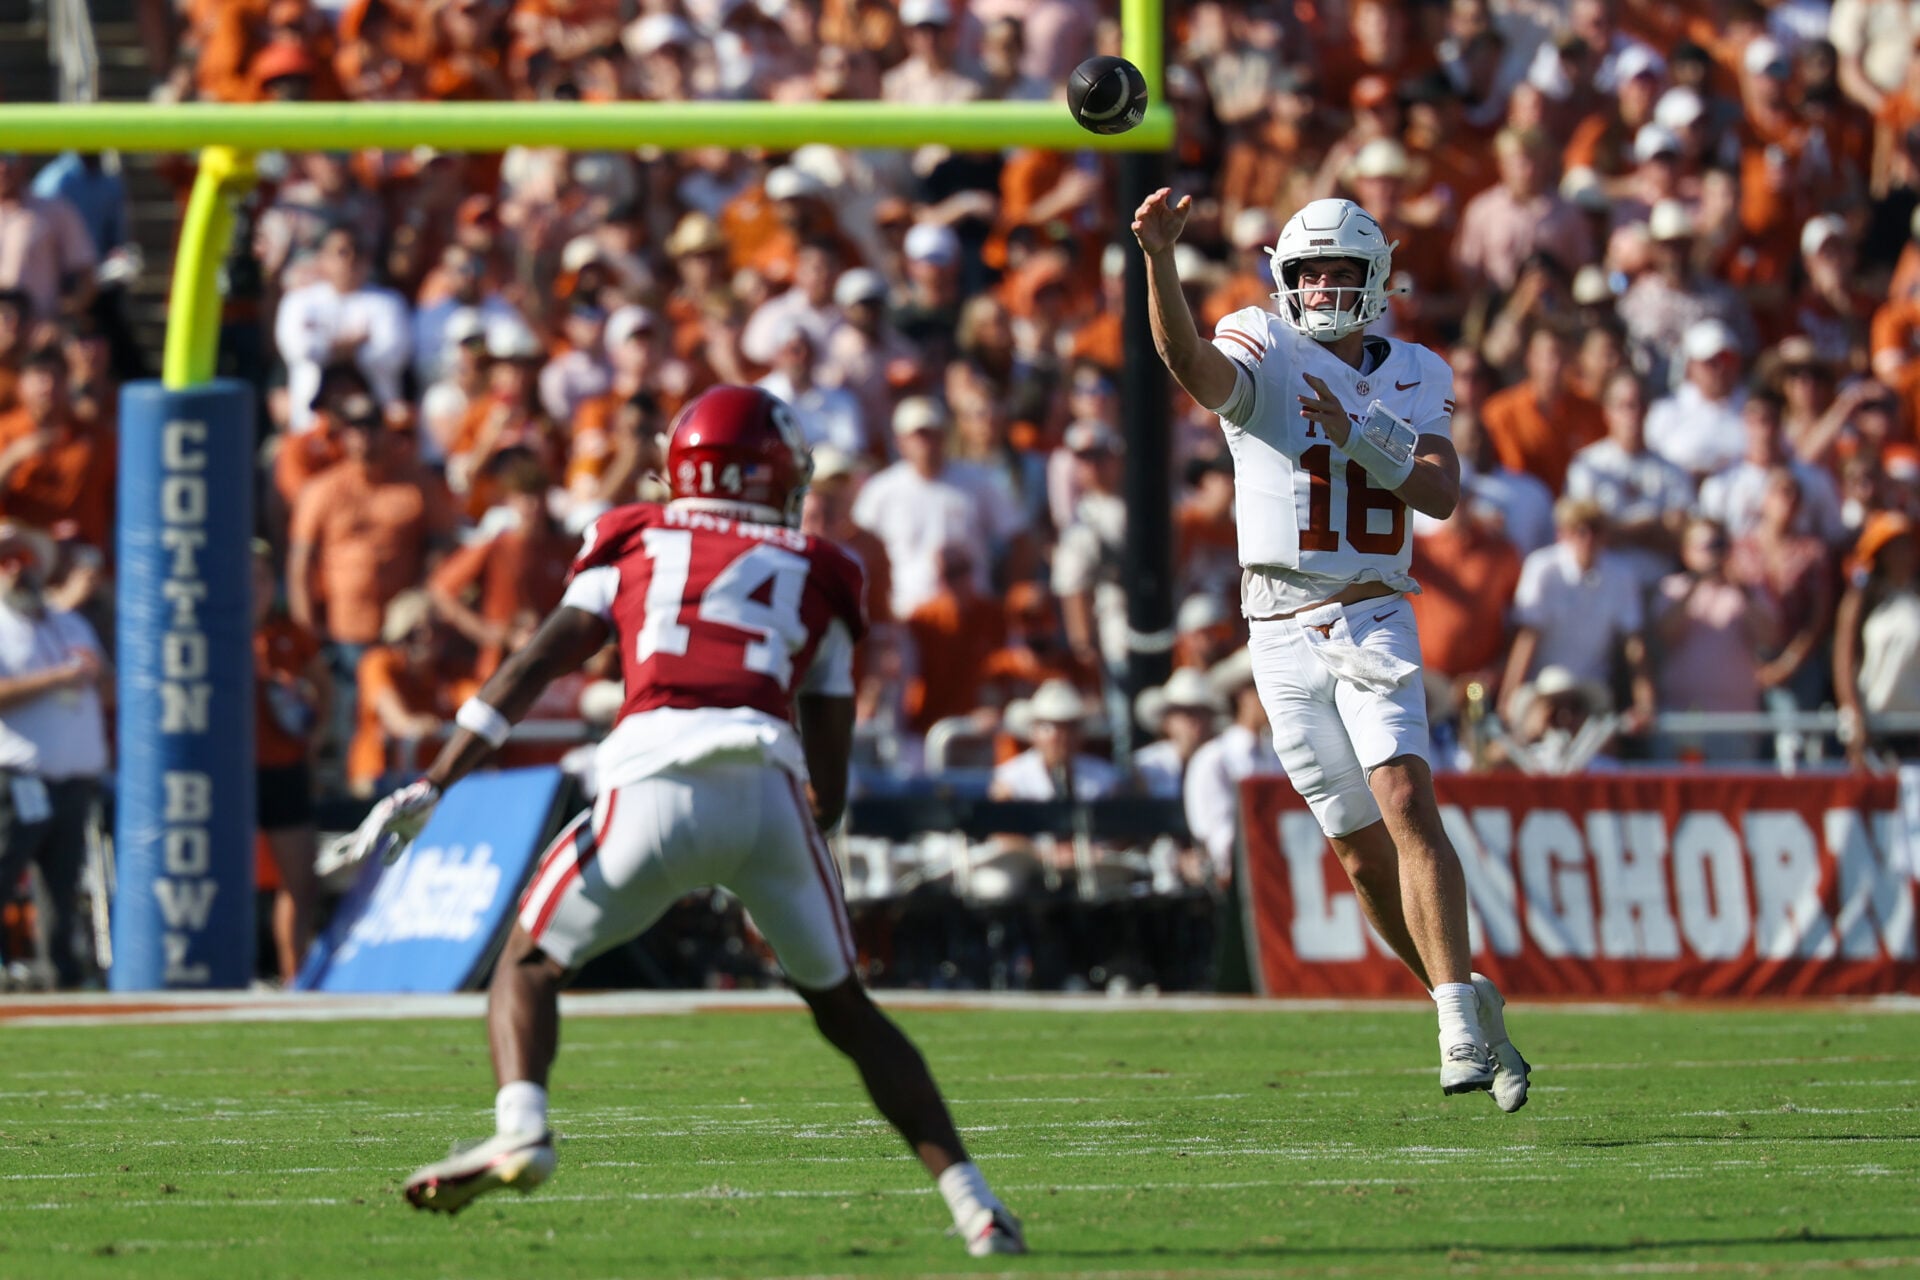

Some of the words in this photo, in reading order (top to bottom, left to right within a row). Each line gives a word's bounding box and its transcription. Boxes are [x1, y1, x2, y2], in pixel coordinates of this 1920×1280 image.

[1309, 238, 1335, 247] HORNS
[700, 460, 742, 494] 14
[1299, 444, 1407, 556] 16
[160, 419, 211, 734] COTTON
[636, 527, 811, 690] 14
[154, 770, 218, 983] BOWL
[1280, 806, 1918, 962] LNGHORN
